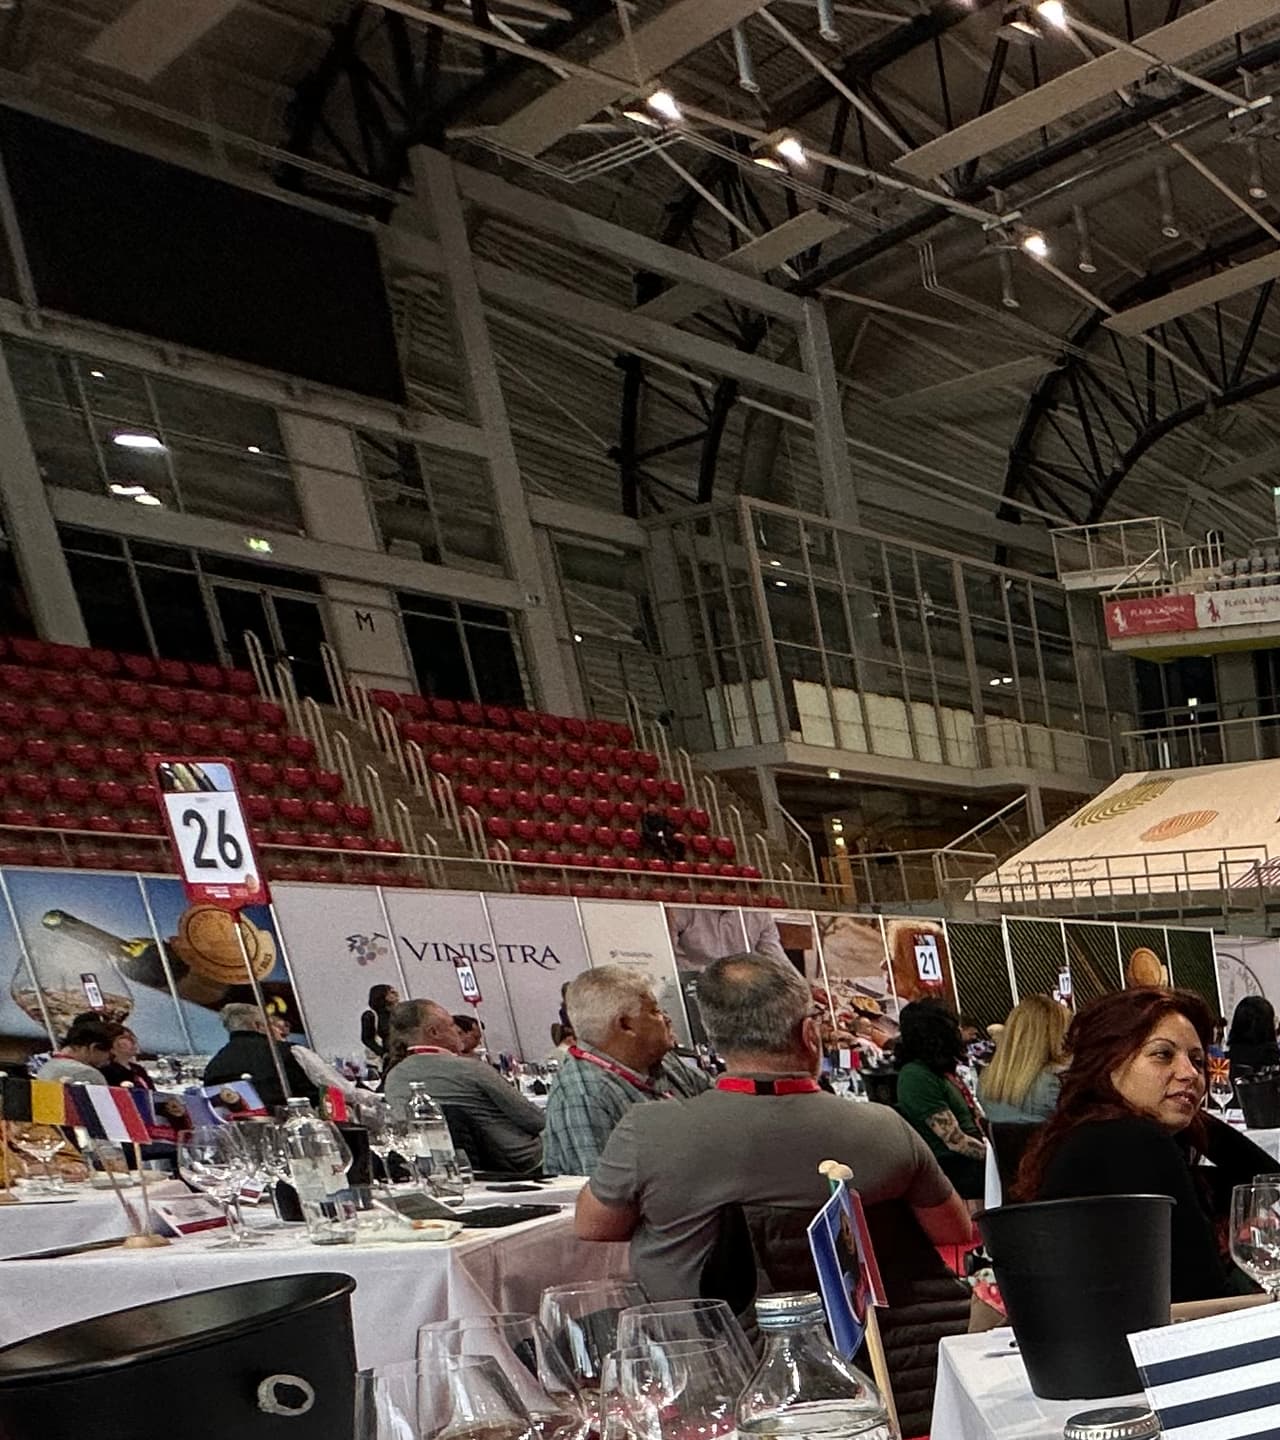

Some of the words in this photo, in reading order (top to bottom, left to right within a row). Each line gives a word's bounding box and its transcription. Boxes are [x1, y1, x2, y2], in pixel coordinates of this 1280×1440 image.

[354, 610, 376, 633] M
[183, 808, 244, 870] 26
[400, 936, 562, 970] VINISTRA
[919, 951, 938, 976] 21
[461, 971, 477, 993] 20
